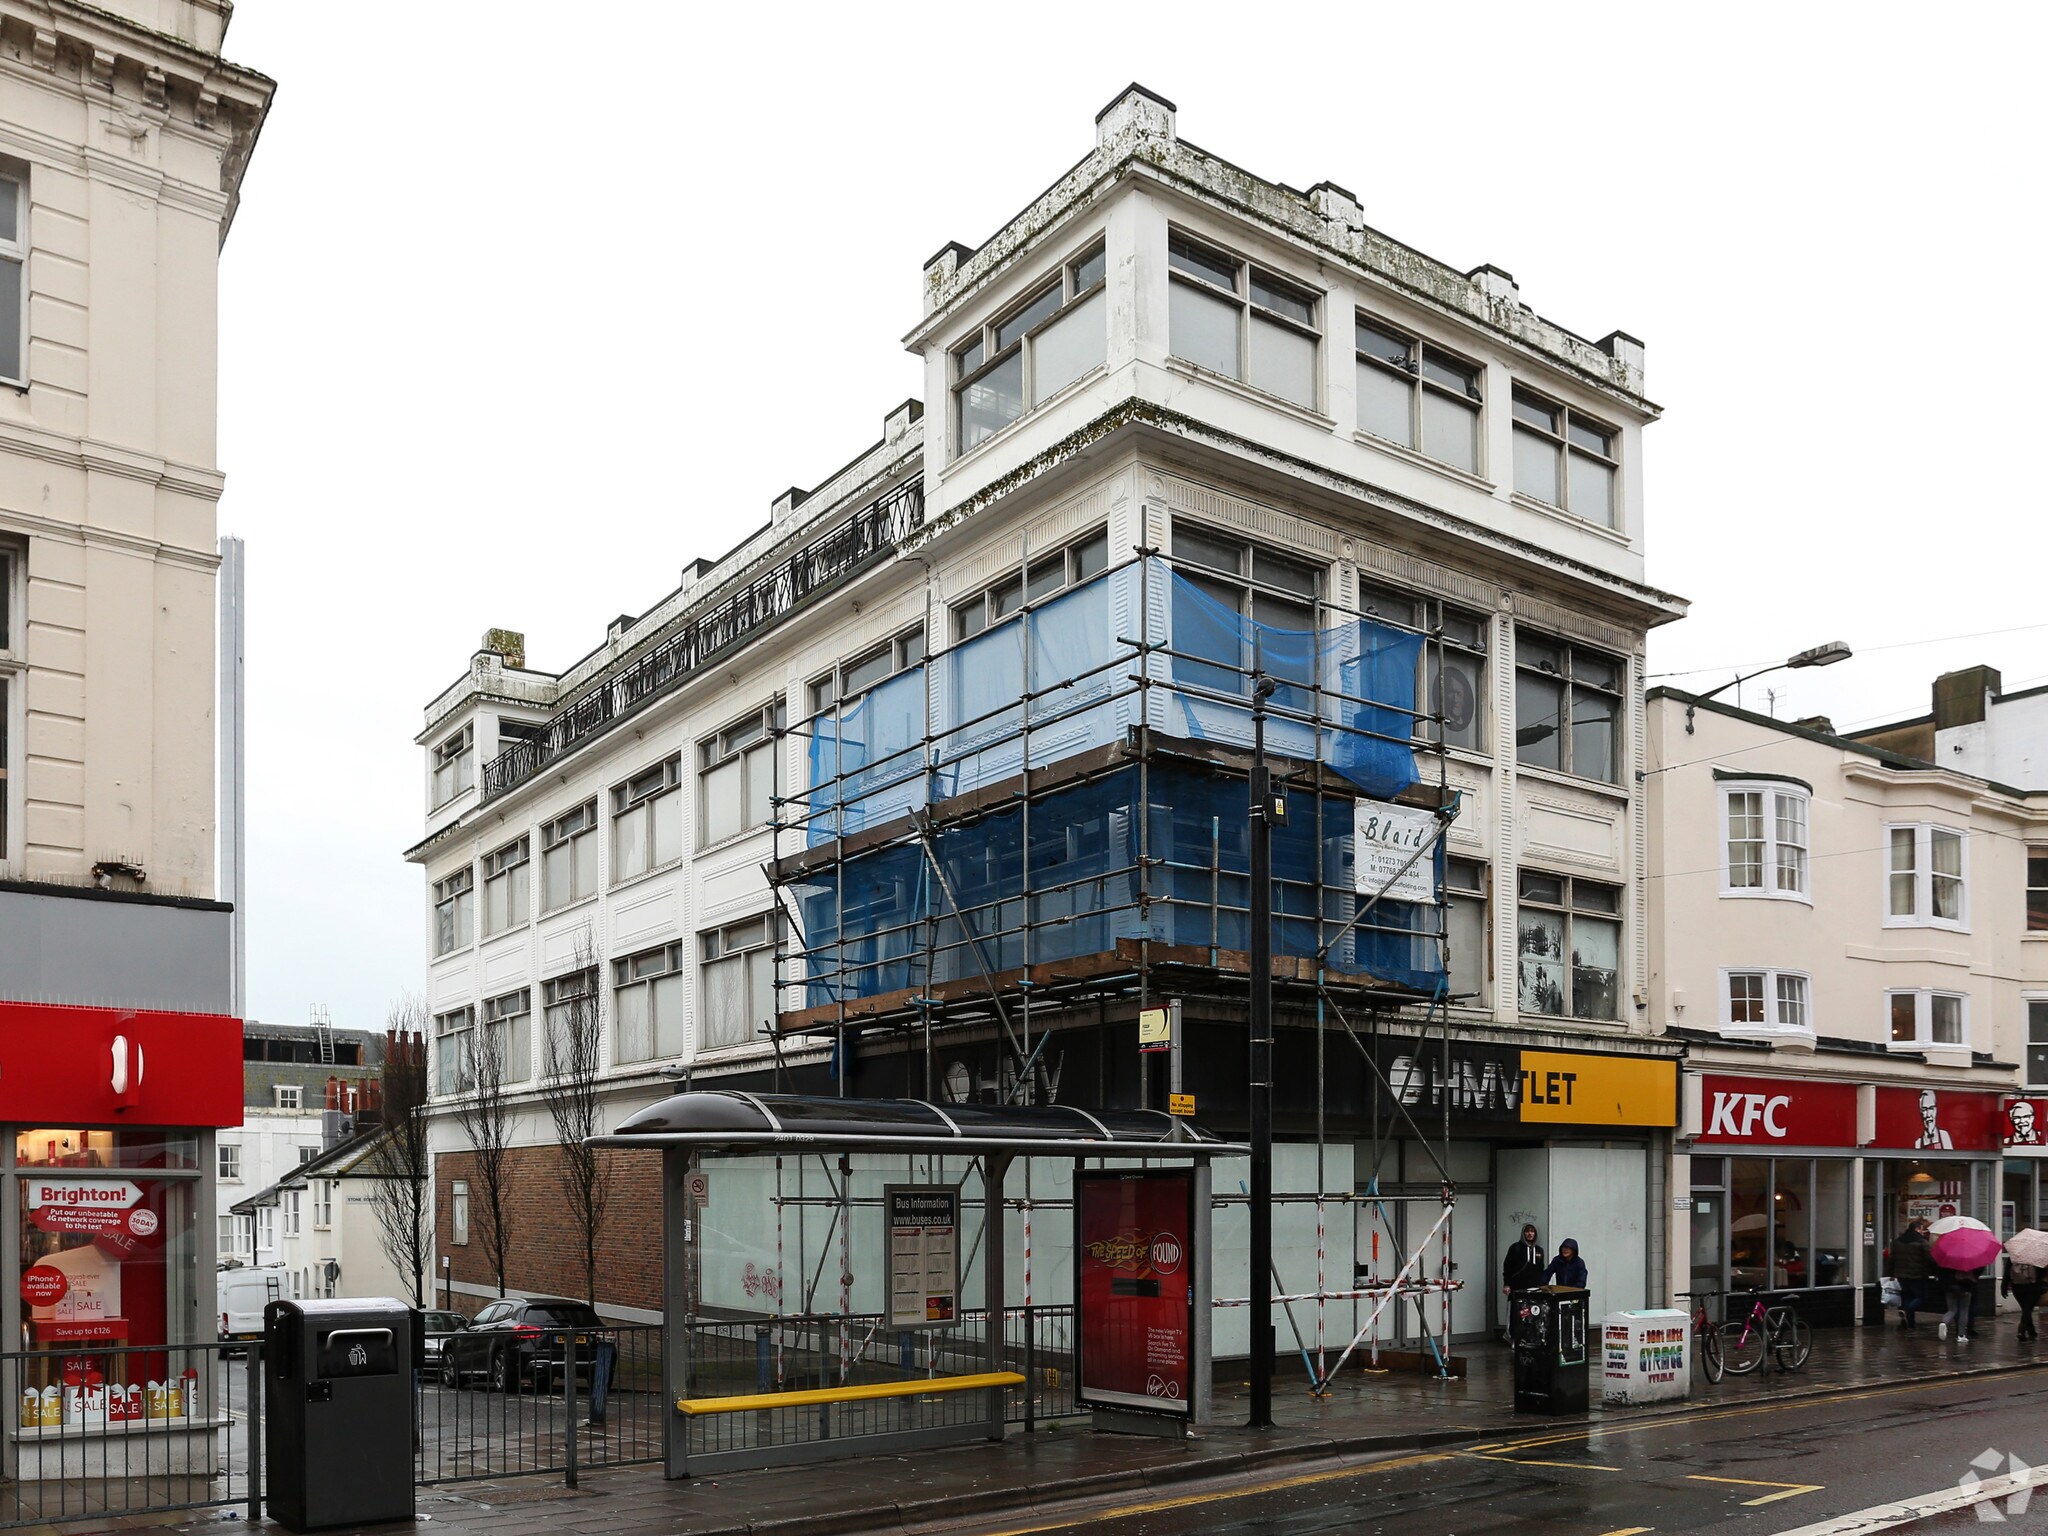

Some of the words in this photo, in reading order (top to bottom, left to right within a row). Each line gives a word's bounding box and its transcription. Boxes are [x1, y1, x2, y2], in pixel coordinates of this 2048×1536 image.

[1365, 816, 1424, 848] Blaid
[1377, 856, 1395, 865] 01273
[1378, 866, 1397, 876] 07768
[1707, 1092, 1790, 1138] KFC
[41, 1187, 127, 1205] Brighton!
[896, 1197, 910, 1209] Bus
[910, 1197, 949, 1209] Information
[78, 1210, 118, 1218] unbeatable
[893, 1214, 952, 1225] www.buses.co.uk
[88, 1217, 121, 1226] coverage
[140, 1219, 155, 1228] DAY
[1091, 1245, 1105, 1257] THE
[1105, 1244, 1136, 1260] SPEED
[1136, 1246, 1149, 1258] OF
[1153, 1242, 1179, 1263] FOUND
[77, 1301, 102, 1311] SALE
[56, 1328, 73, 1336] Save
[74, 1329, 83, 1337] up
[93, 1327, 111, 1335] £126
[66, 1360, 92, 1371] SALE
[74, 1400, 109, 1413] SALE
[33, 1406, 61, 1419] SALE
